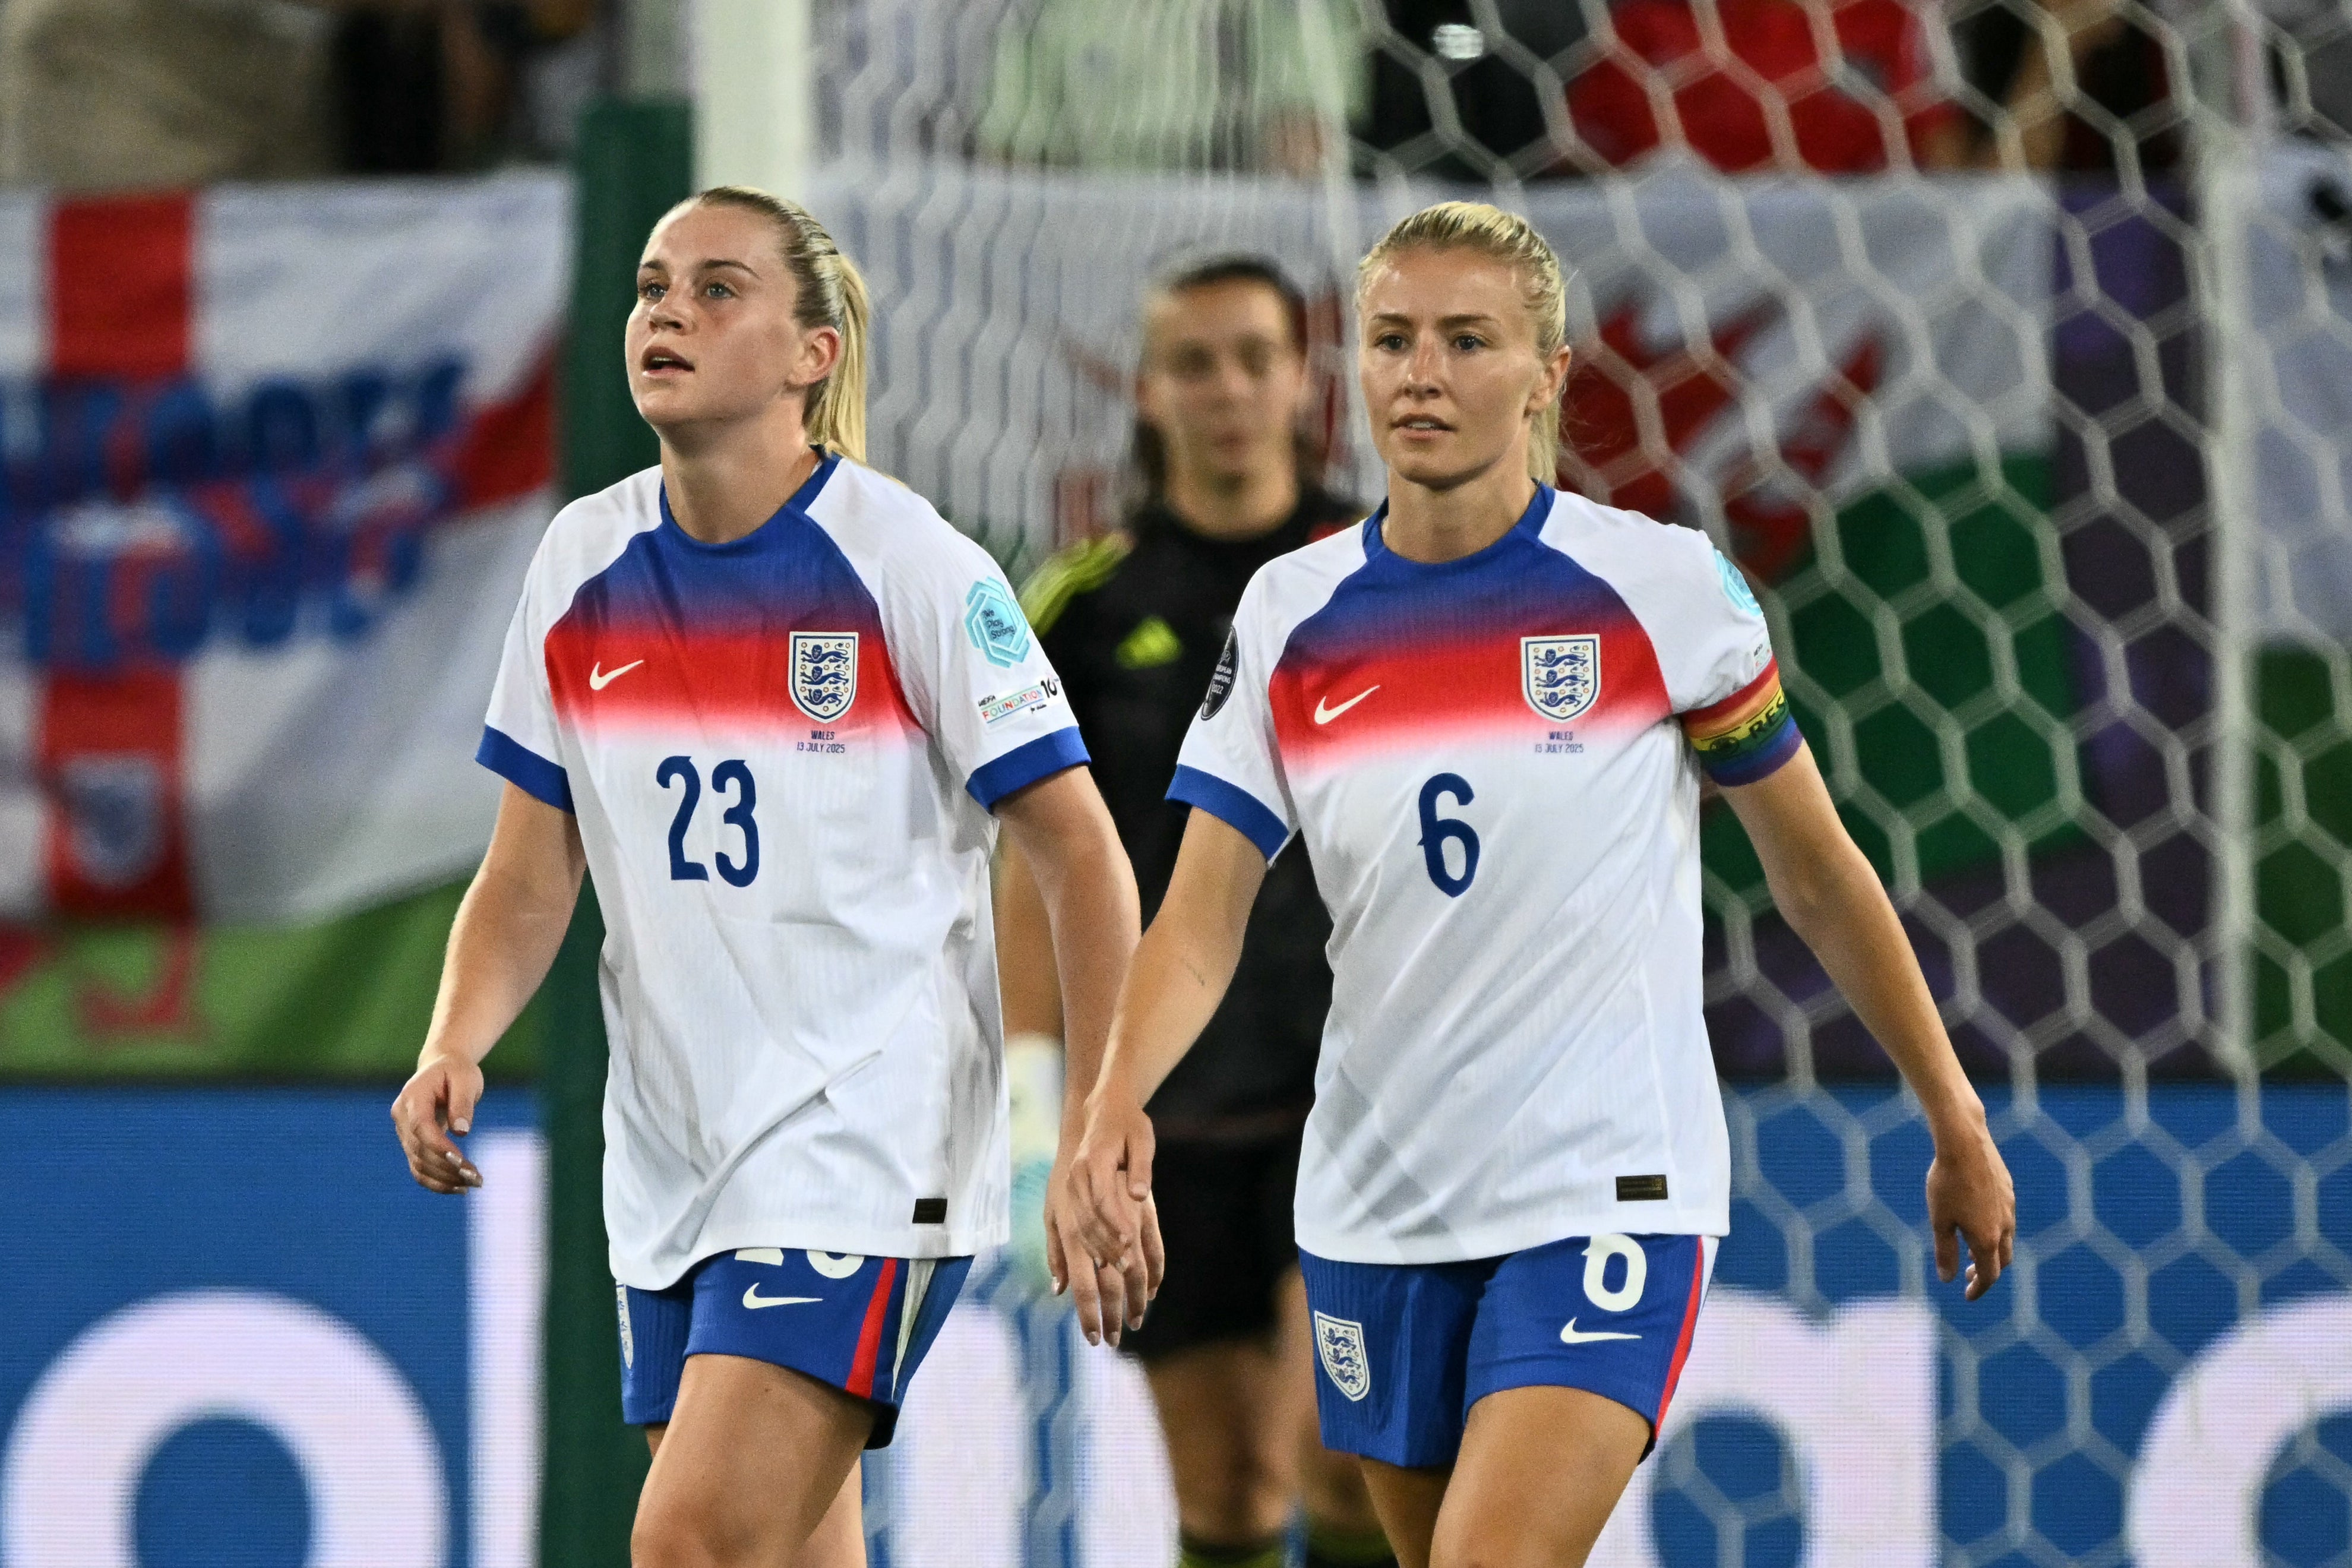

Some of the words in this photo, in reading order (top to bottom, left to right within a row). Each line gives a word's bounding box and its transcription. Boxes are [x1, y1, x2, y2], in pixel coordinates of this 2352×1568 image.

[982, 688, 1043, 720] FOUNDATION
[811, 730, 835, 740] WALES
[1549, 731, 1573, 741] WALES
[796, 742, 804, 751] 13
[806, 742, 824, 752] JULY
[826, 744, 845, 753] 2025
[1535, 744, 1542, 753] 13
[1545, 743, 1563, 753] JULY
[1565, 744, 1584, 753] 2025
[656, 755, 760, 887] 23
[1417, 772, 1480, 898] 6
